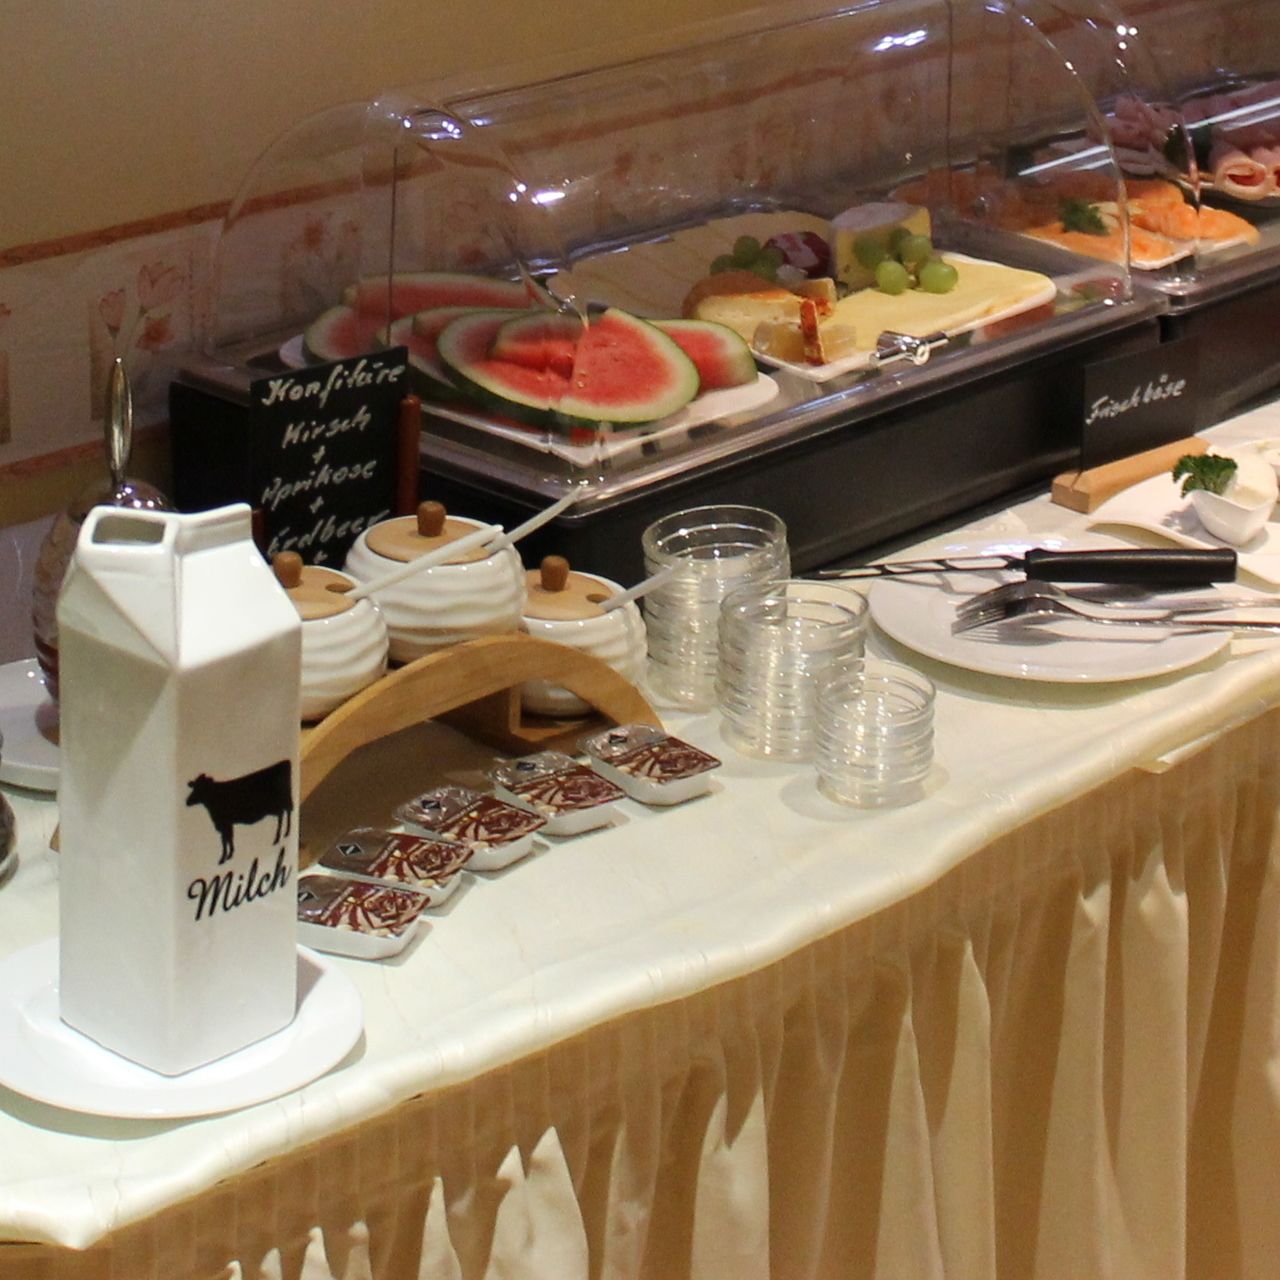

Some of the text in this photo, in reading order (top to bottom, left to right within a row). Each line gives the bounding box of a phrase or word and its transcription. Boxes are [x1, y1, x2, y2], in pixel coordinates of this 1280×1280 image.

[262, 359, 405, 409] Konfitüre
[281, 405, 373, 450] Kirsch
[261, 460, 377, 512] Aprikose
[187, 846, 293, 922] Milch
